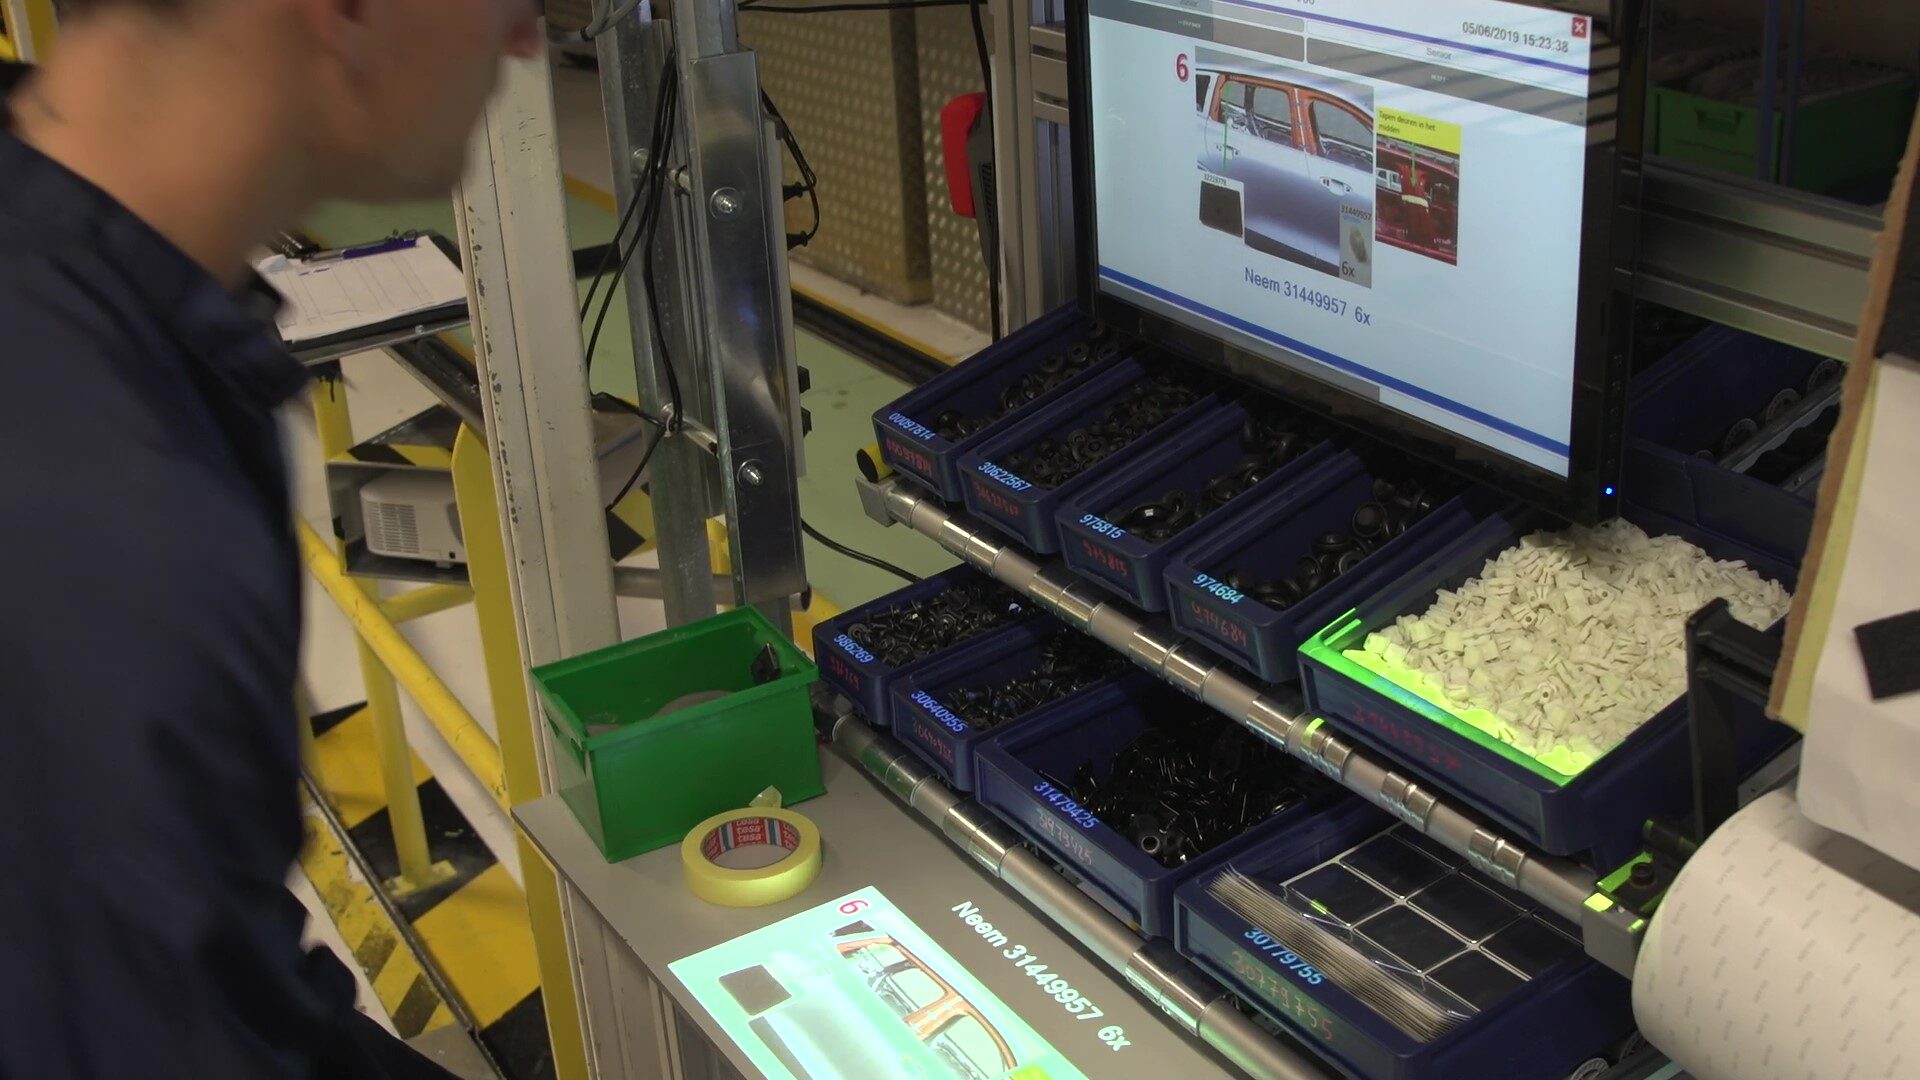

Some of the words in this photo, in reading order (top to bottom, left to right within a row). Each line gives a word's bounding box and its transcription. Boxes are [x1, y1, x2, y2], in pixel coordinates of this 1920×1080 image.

[1462, 21, 1520, 44] 05/06/2019
[1522, 33, 1569, 53] 15:23:38
[1175, 53, 1189, 82] 6
[1340, 203, 1372, 221] 31449957
[1341, 260, 1355, 278] 6x
[1244, 267, 1280, 293] Neem
[1284, 280, 1347, 317] 31449957
[1354, 306, 1371, 326] 6x
[888, 412, 936, 441] 00097814
[978, 461, 1033, 492] 30622567
[1079, 513, 1128, 540] 975815
[1192, 573, 1245, 605] 974684
[833, 633, 875, 664] 986269
[911, 690, 969, 733] 30640955
[1033, 781, 1100, 829] 31479425
[839, 899, 869, 915] 6
[1244, 926, 1327, 985] 30779755
[951, 900, 1008, 948] Neem
[1002, 944, 1104, 1020] 31449957
[1097, 1025, 1132, 1052] 6x
